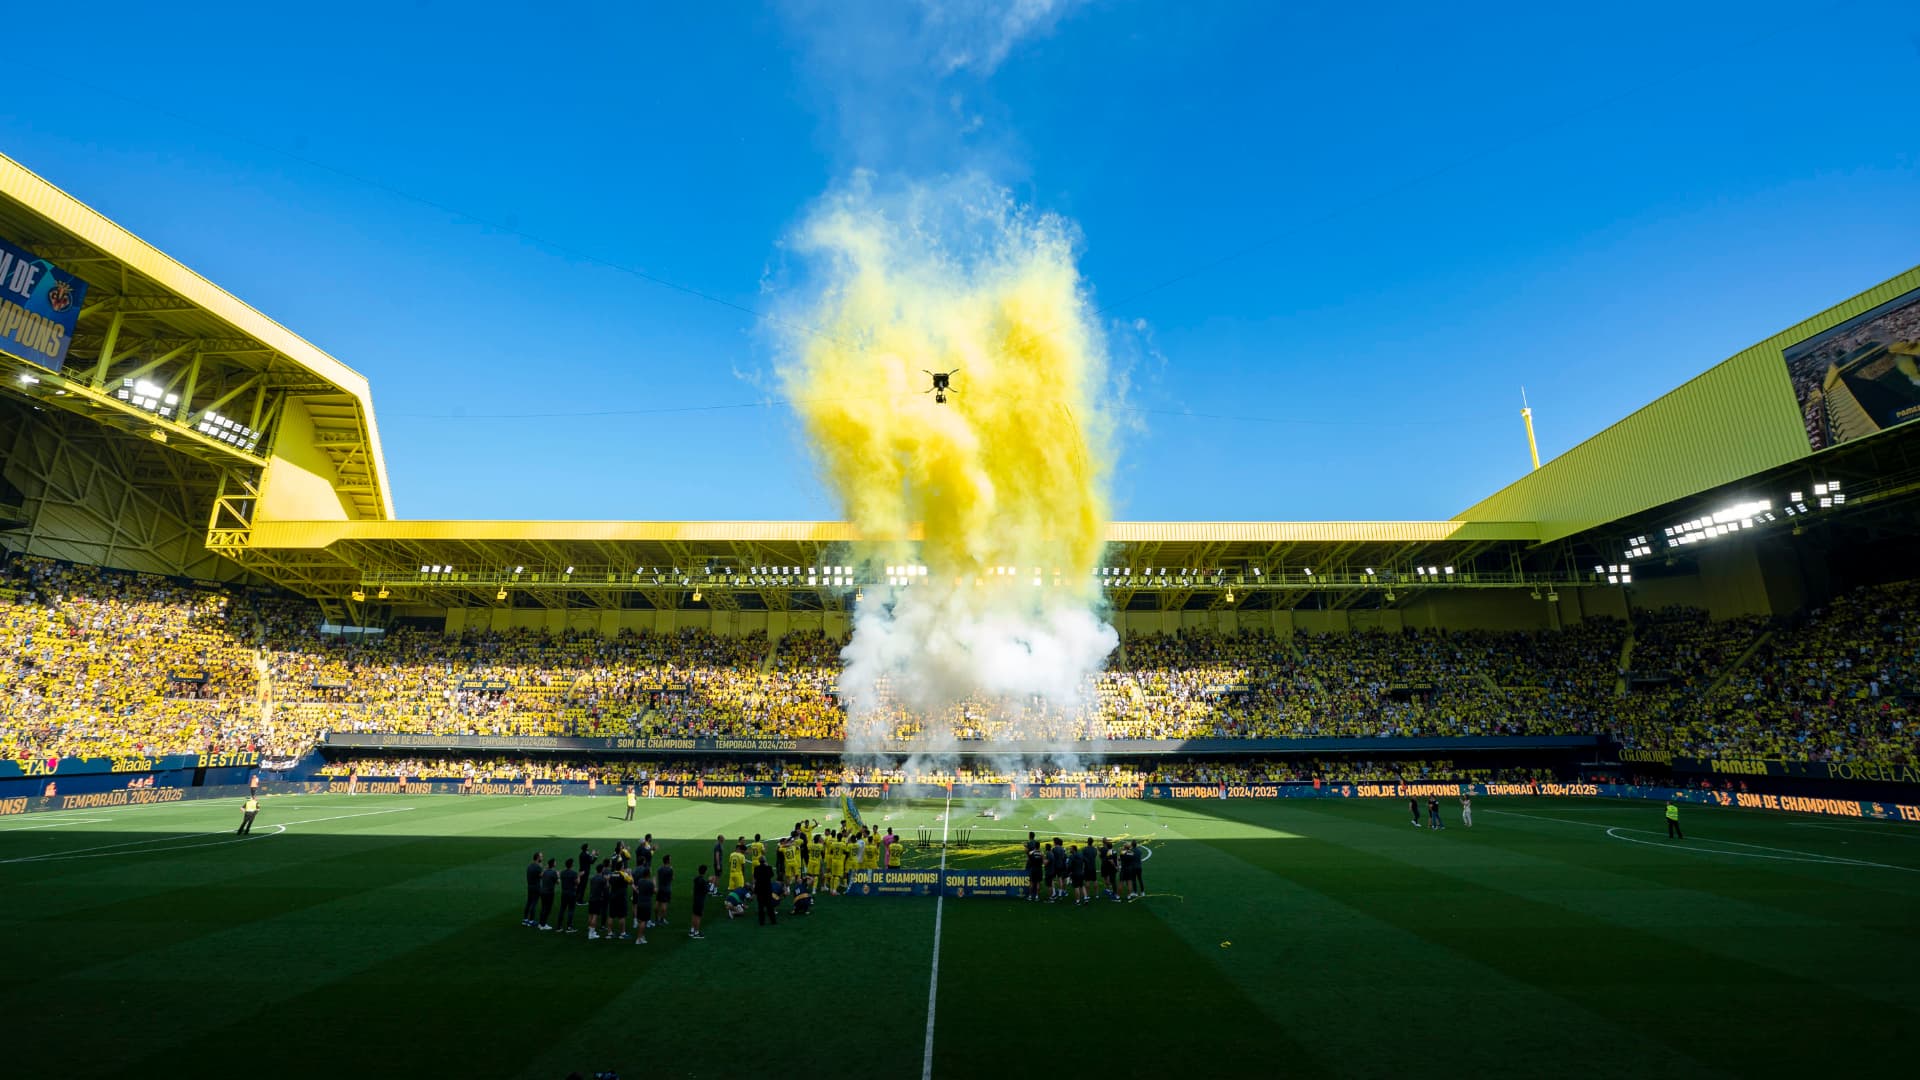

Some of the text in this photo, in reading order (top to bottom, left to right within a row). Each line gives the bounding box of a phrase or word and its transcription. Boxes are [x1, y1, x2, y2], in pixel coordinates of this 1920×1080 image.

[9, 259, 40, 298] DE
[383, 736, 459, 745] SOM DE CHAMPIONS!
[479, 737, 518, 746] TEMPORADA
[617, 739, 696, 749] SOM DE CHAMPIONS!
[715, 740, 797, 750] TEMPORADA 2024/2025
[1711, 759, 1768, 776] PAMESA
[356, 782, 369, 793] DE
[370, 782, 432, 794] CHAMIONS!
[513, 784, 562, 795] 204/2025
[642, 785, 664, 797] SM
[667, 785, 680, 796] DE
[1039, 786, 1063, 798] SOM
[1065, 786, 1078, 798] DE
[1170, 786, 1278, 798] TEMPORAD 2024/2025
[1357, 784, 1460, 797] SOM DE CHAMPIONS!
[1541, 784, 1598, 796] 2024/2025
[62, 788, 184, 809] TEMPORADA 2024/2025
[1736, 793, 1863, 817] SOM DE CHAMPIONS!
[873, 872, 884, 884] DE
[885, 872, 938, 884] CHAMPIONS!
[946, 876, 966, 887] SOM
[967, 876, 978, 887] DE
